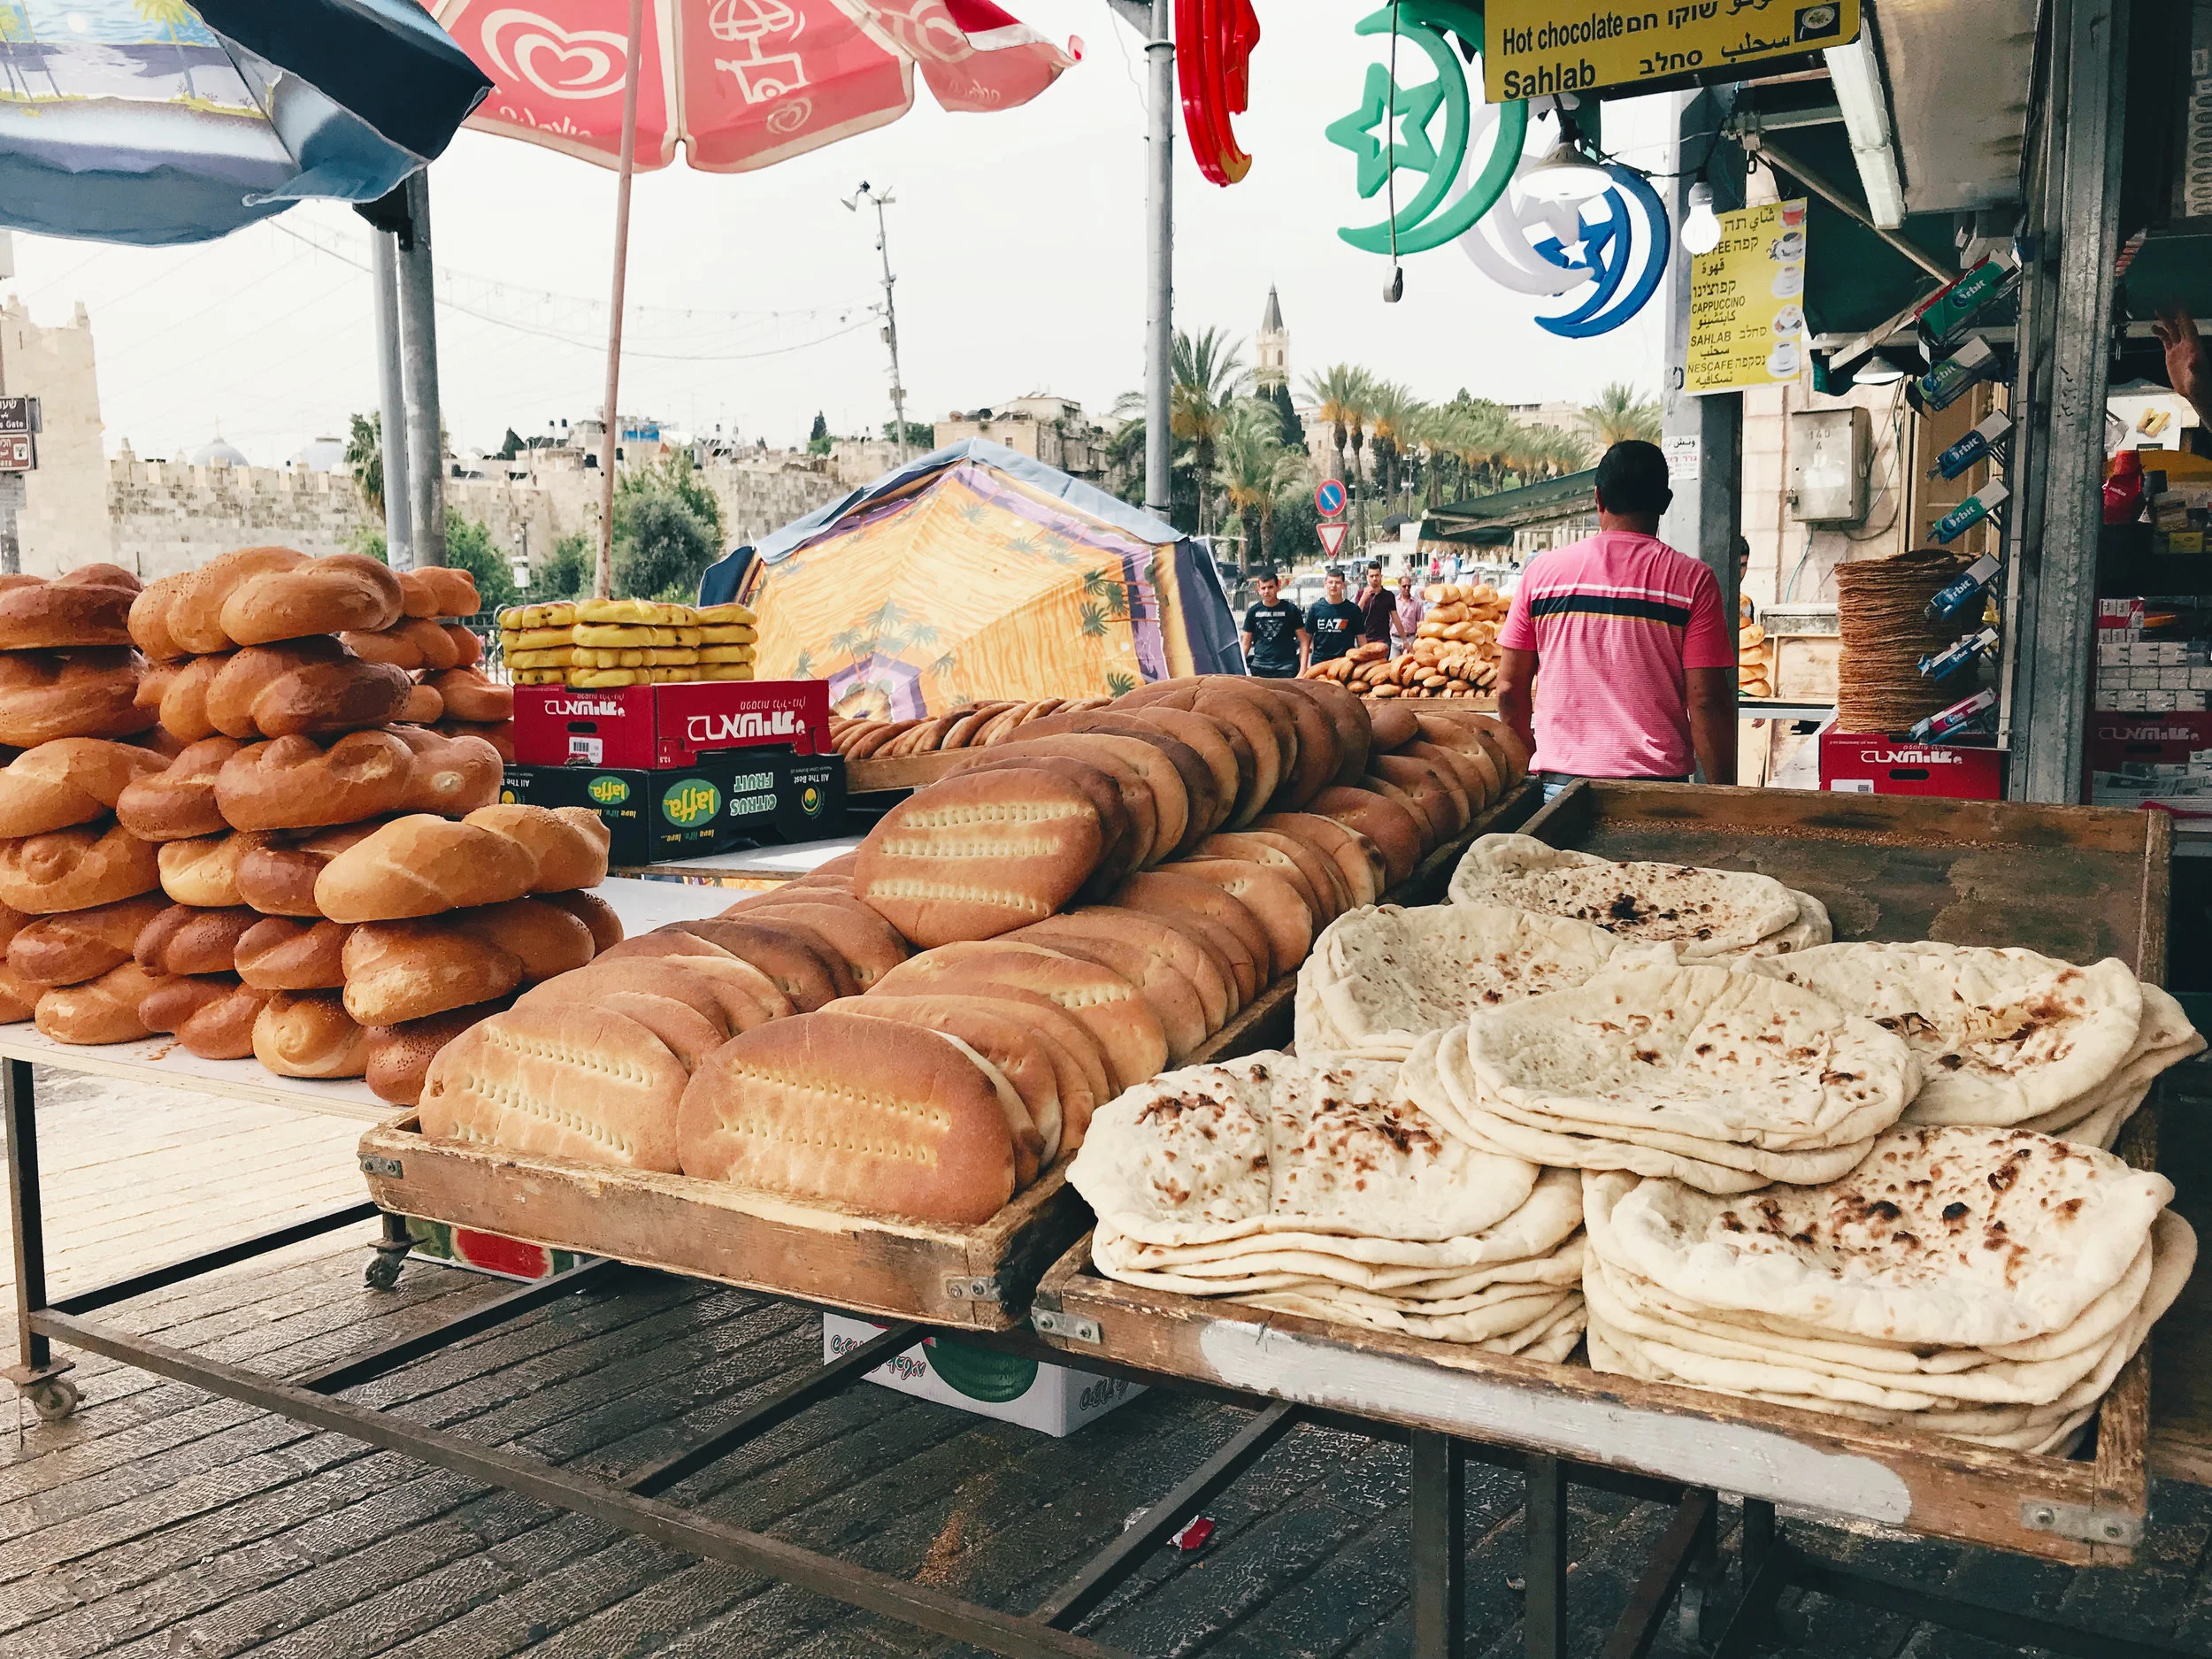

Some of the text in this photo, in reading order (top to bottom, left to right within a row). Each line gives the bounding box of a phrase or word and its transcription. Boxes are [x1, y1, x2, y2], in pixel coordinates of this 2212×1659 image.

[1626, 13, 1658, 34] חם
[1667, 1, 1718, 30] שוקו
[1502, 12, 1624, 56] Hot chocolate
[1720, 32, 1790, 64] سحلب
[1639, 50, 1703, 75] סחלב
[1503, 58, 1596, 100] Sahlab
[1724, 218, 1747, 232] תה
[1749, 207, 1775, 231] شاي
[1733, 236, 1759, 252] קפה
[1701, 257, 1725, 276] قهوة
[1692, 296, 1746, 314] CAPPUCCINO
[1690, 331, 1732, 347] SAHLAB
[1740, 325, 1767, 340] סחלב
[1687, 359, 1733, 373] NESCAFE
[1735, 355, 1766, 370] נסקפה
[1949, 437, 1979, 462] Orbit
[1944, 505, 1976, 531] Orbit
[1942, 580, 1972, 603] Orbit
[1317, 618, 1342, 630] EA7
[733, 772, 774, 793] FRUIT
[794, 773, 830, 784] All The Best
[729, 794, 777, 817] CITRUS
